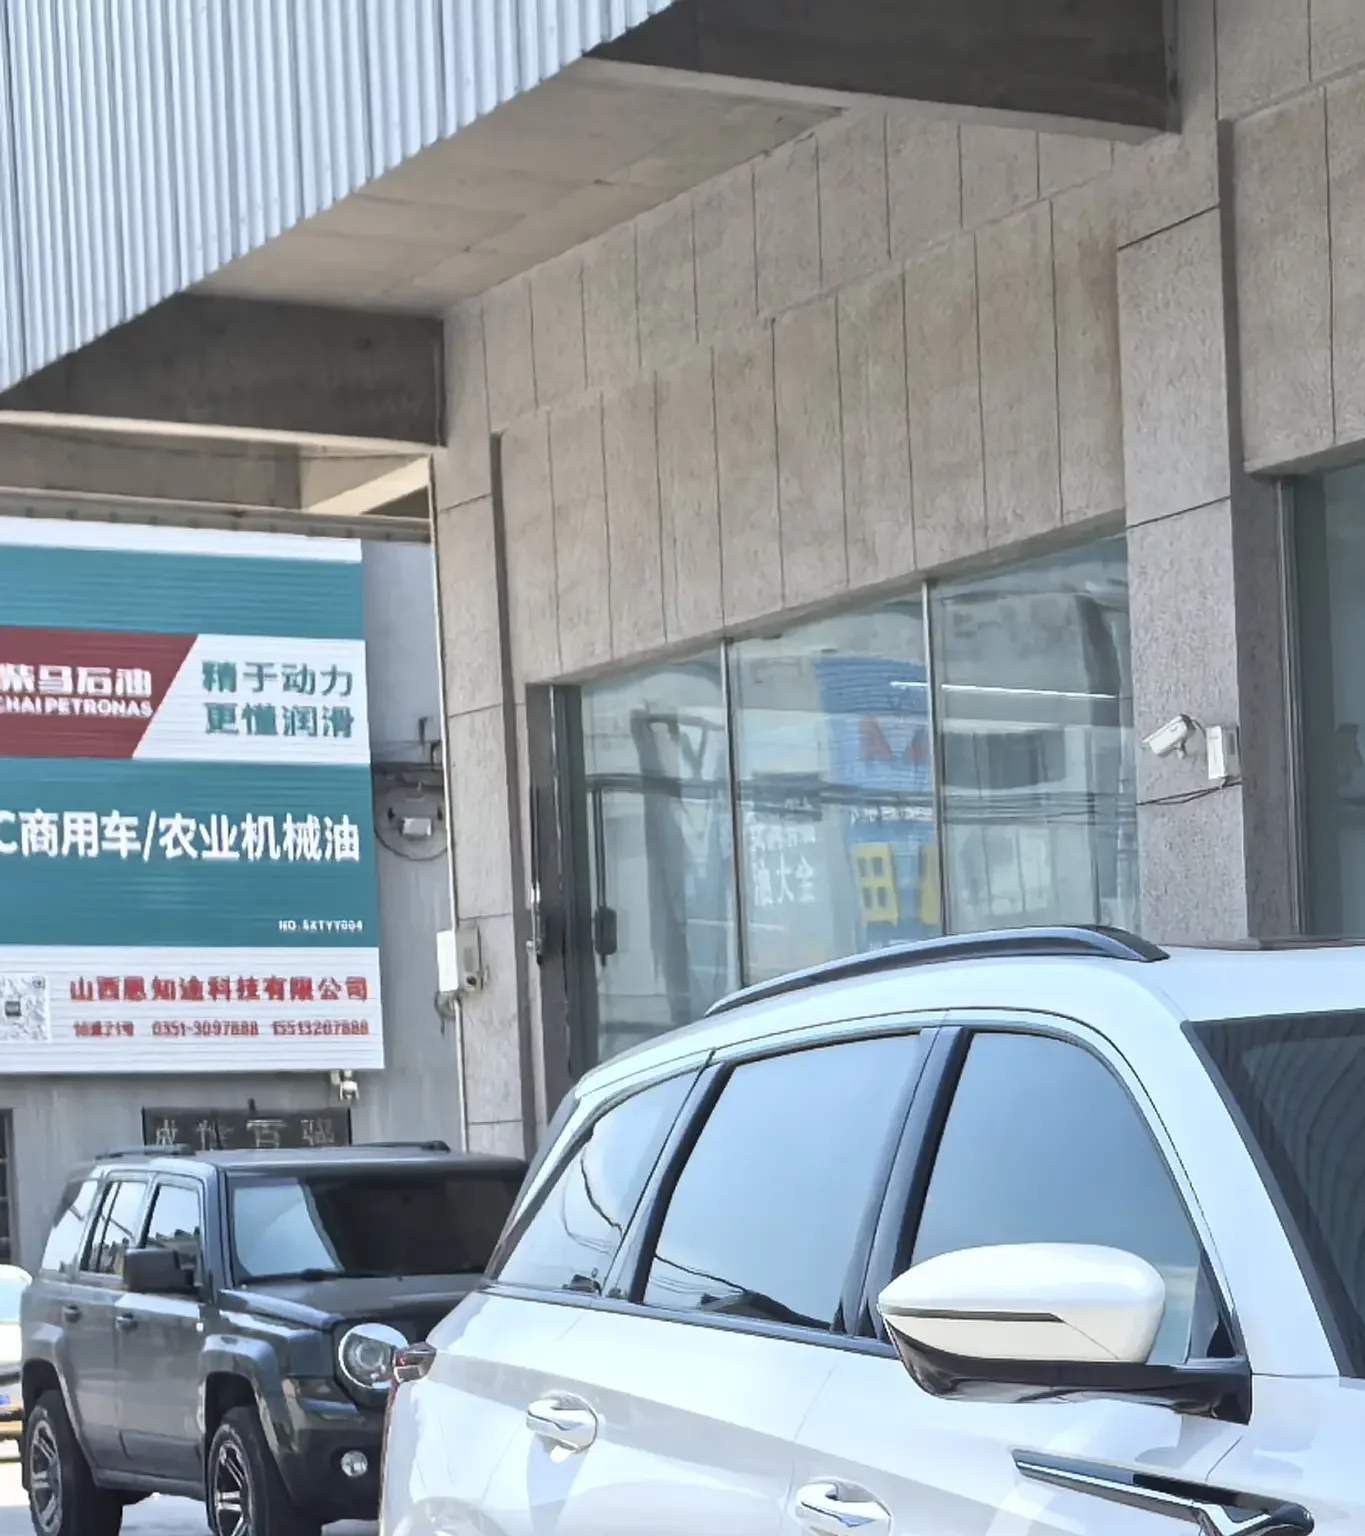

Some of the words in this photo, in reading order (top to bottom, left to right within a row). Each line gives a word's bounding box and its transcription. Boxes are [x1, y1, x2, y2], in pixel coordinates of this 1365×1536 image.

[202, 661, 353, 696] 精于动力
[44, 697, 153, 718] PETRONAS
[204, 702, 354, 738] 更懂润滑
